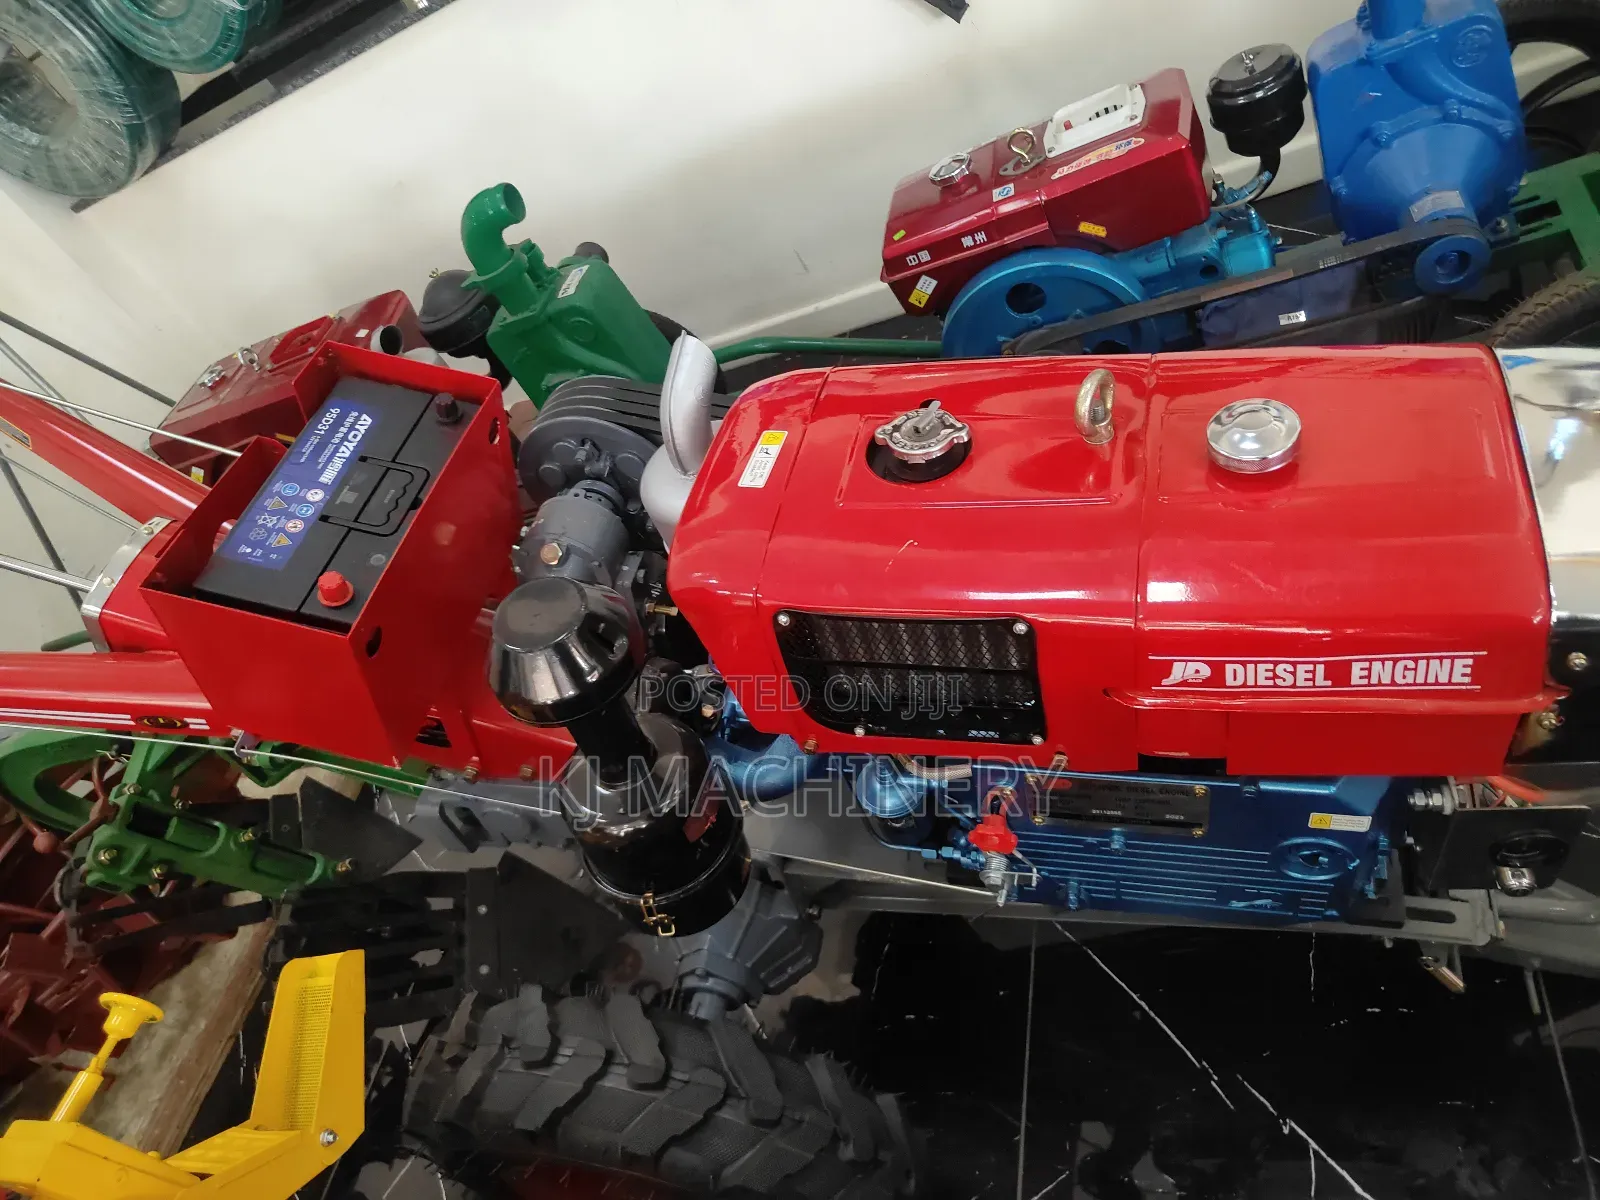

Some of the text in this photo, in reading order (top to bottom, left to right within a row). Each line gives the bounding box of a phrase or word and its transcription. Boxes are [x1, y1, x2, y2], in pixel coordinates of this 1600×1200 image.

[314, 407, 341, 435] 95D31
[335, 413, 373, 458] AYOYA
[1224, 662, 1332, 686] DIESEL
[1350, 658, 1474, 685] ENGINE
